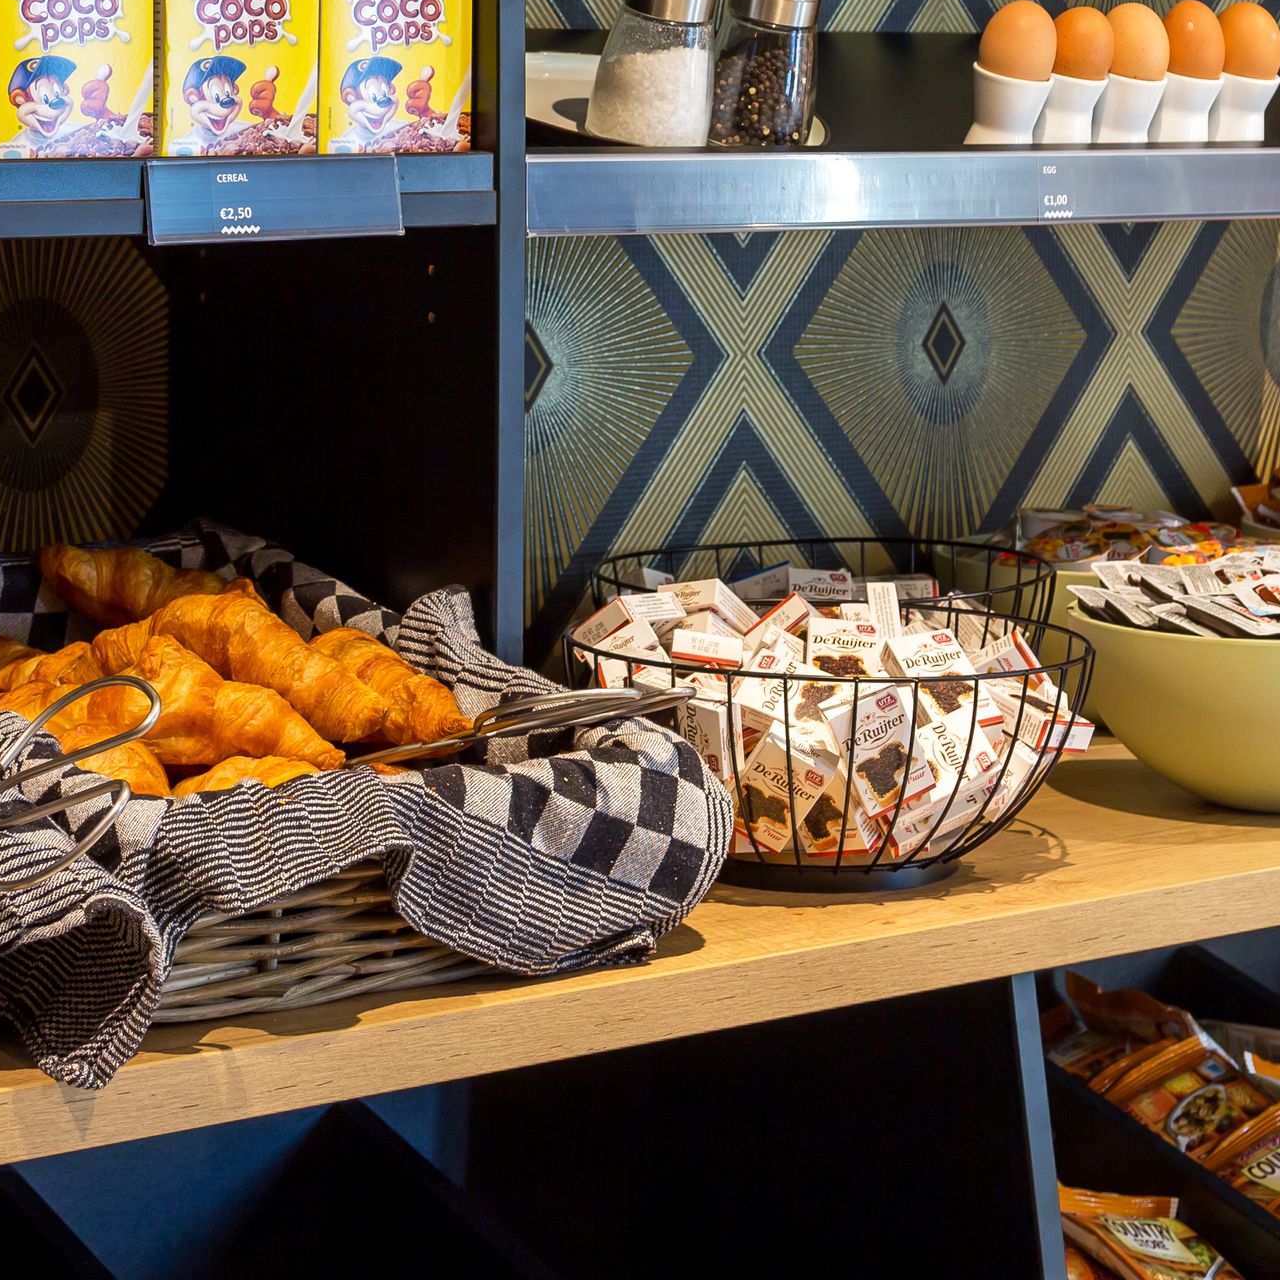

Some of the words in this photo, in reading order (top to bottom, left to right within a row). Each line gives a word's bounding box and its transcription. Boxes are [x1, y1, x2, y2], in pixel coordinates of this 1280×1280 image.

[1042, 166, 1057, 174] EGG
[216, 173, 249, 183] CEREAL
[1043, 195, 1068, 207] €1,00
[220, 207, 252, 221] €2,50
